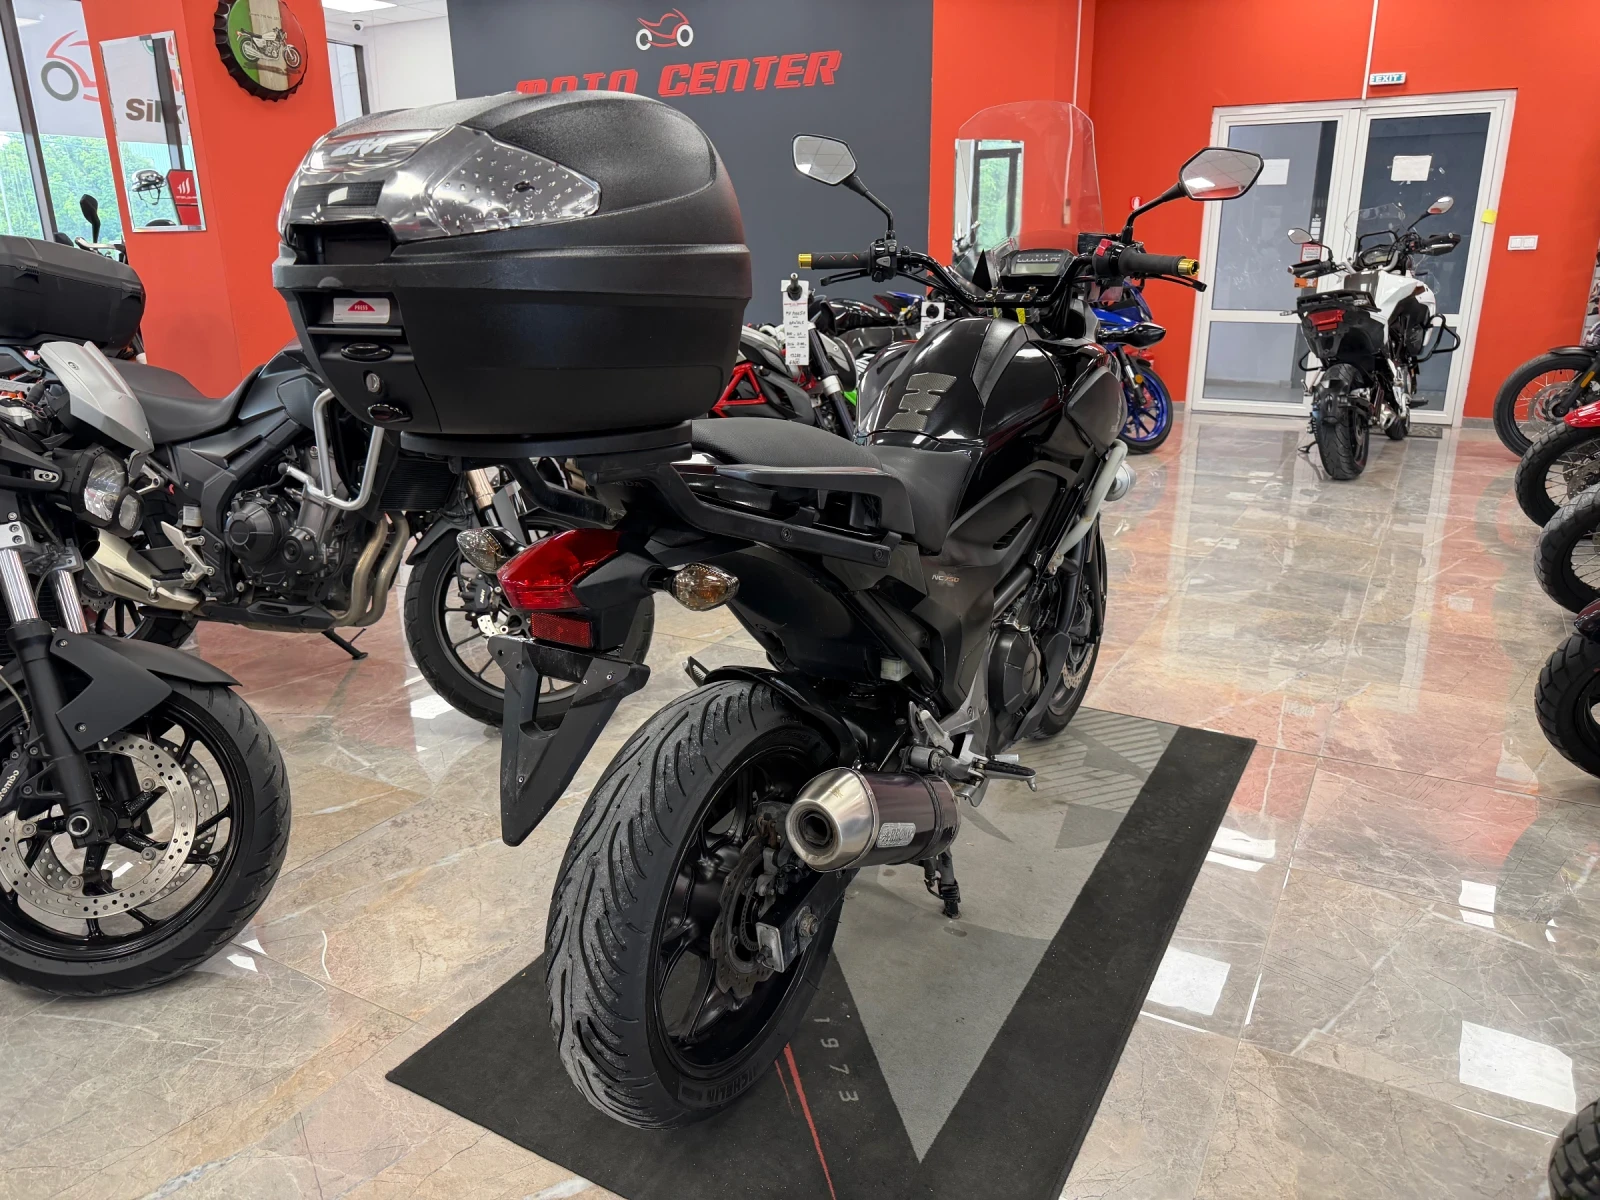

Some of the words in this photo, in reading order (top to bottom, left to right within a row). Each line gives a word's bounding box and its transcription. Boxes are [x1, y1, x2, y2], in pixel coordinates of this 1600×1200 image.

[657, 50, 842, 97] CENTER
[1375, 74, 1399, 83] EXIT
[125, 98, 186, 125] Silk
[931, 574, 960, 583] NC750
